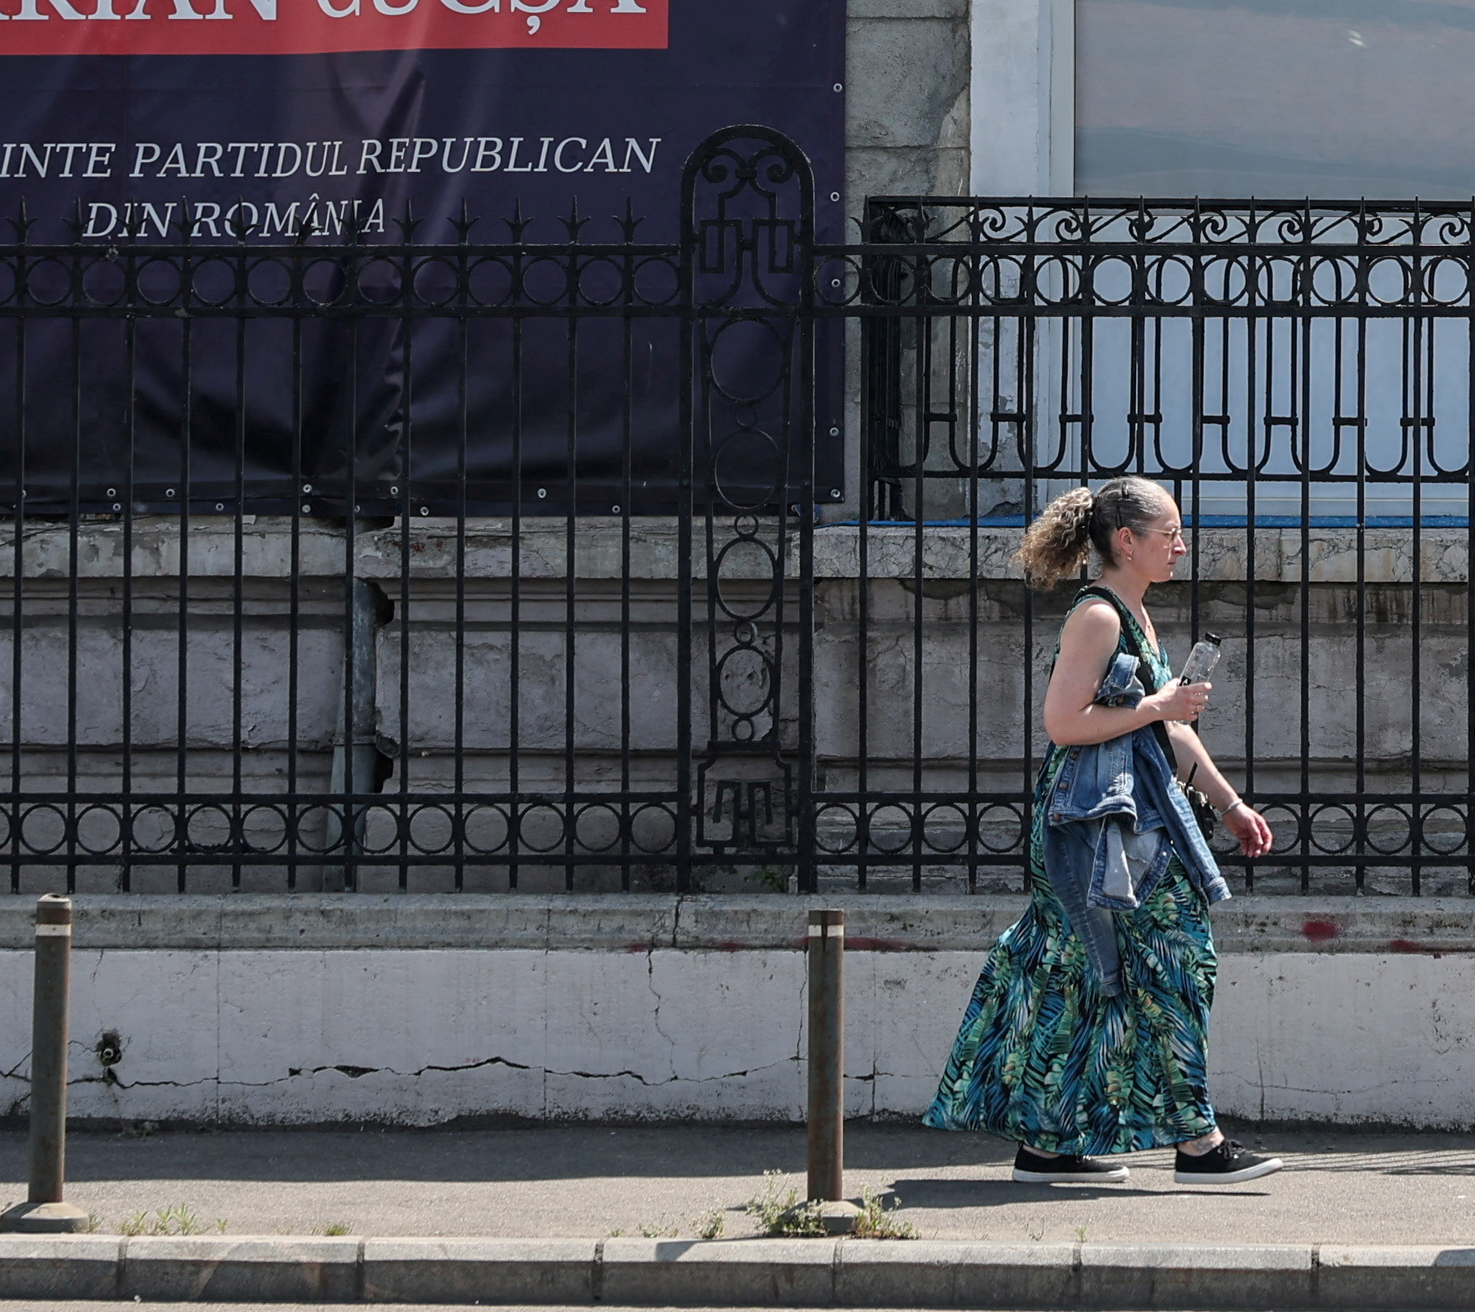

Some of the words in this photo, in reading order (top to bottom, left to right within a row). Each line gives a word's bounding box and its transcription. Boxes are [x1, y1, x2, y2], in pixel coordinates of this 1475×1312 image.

[128, 141, 348, 180] PARTIDUL
[356, 138, 663, 175] REPUBLICAN
[82, 201, 178, 238] DIN
